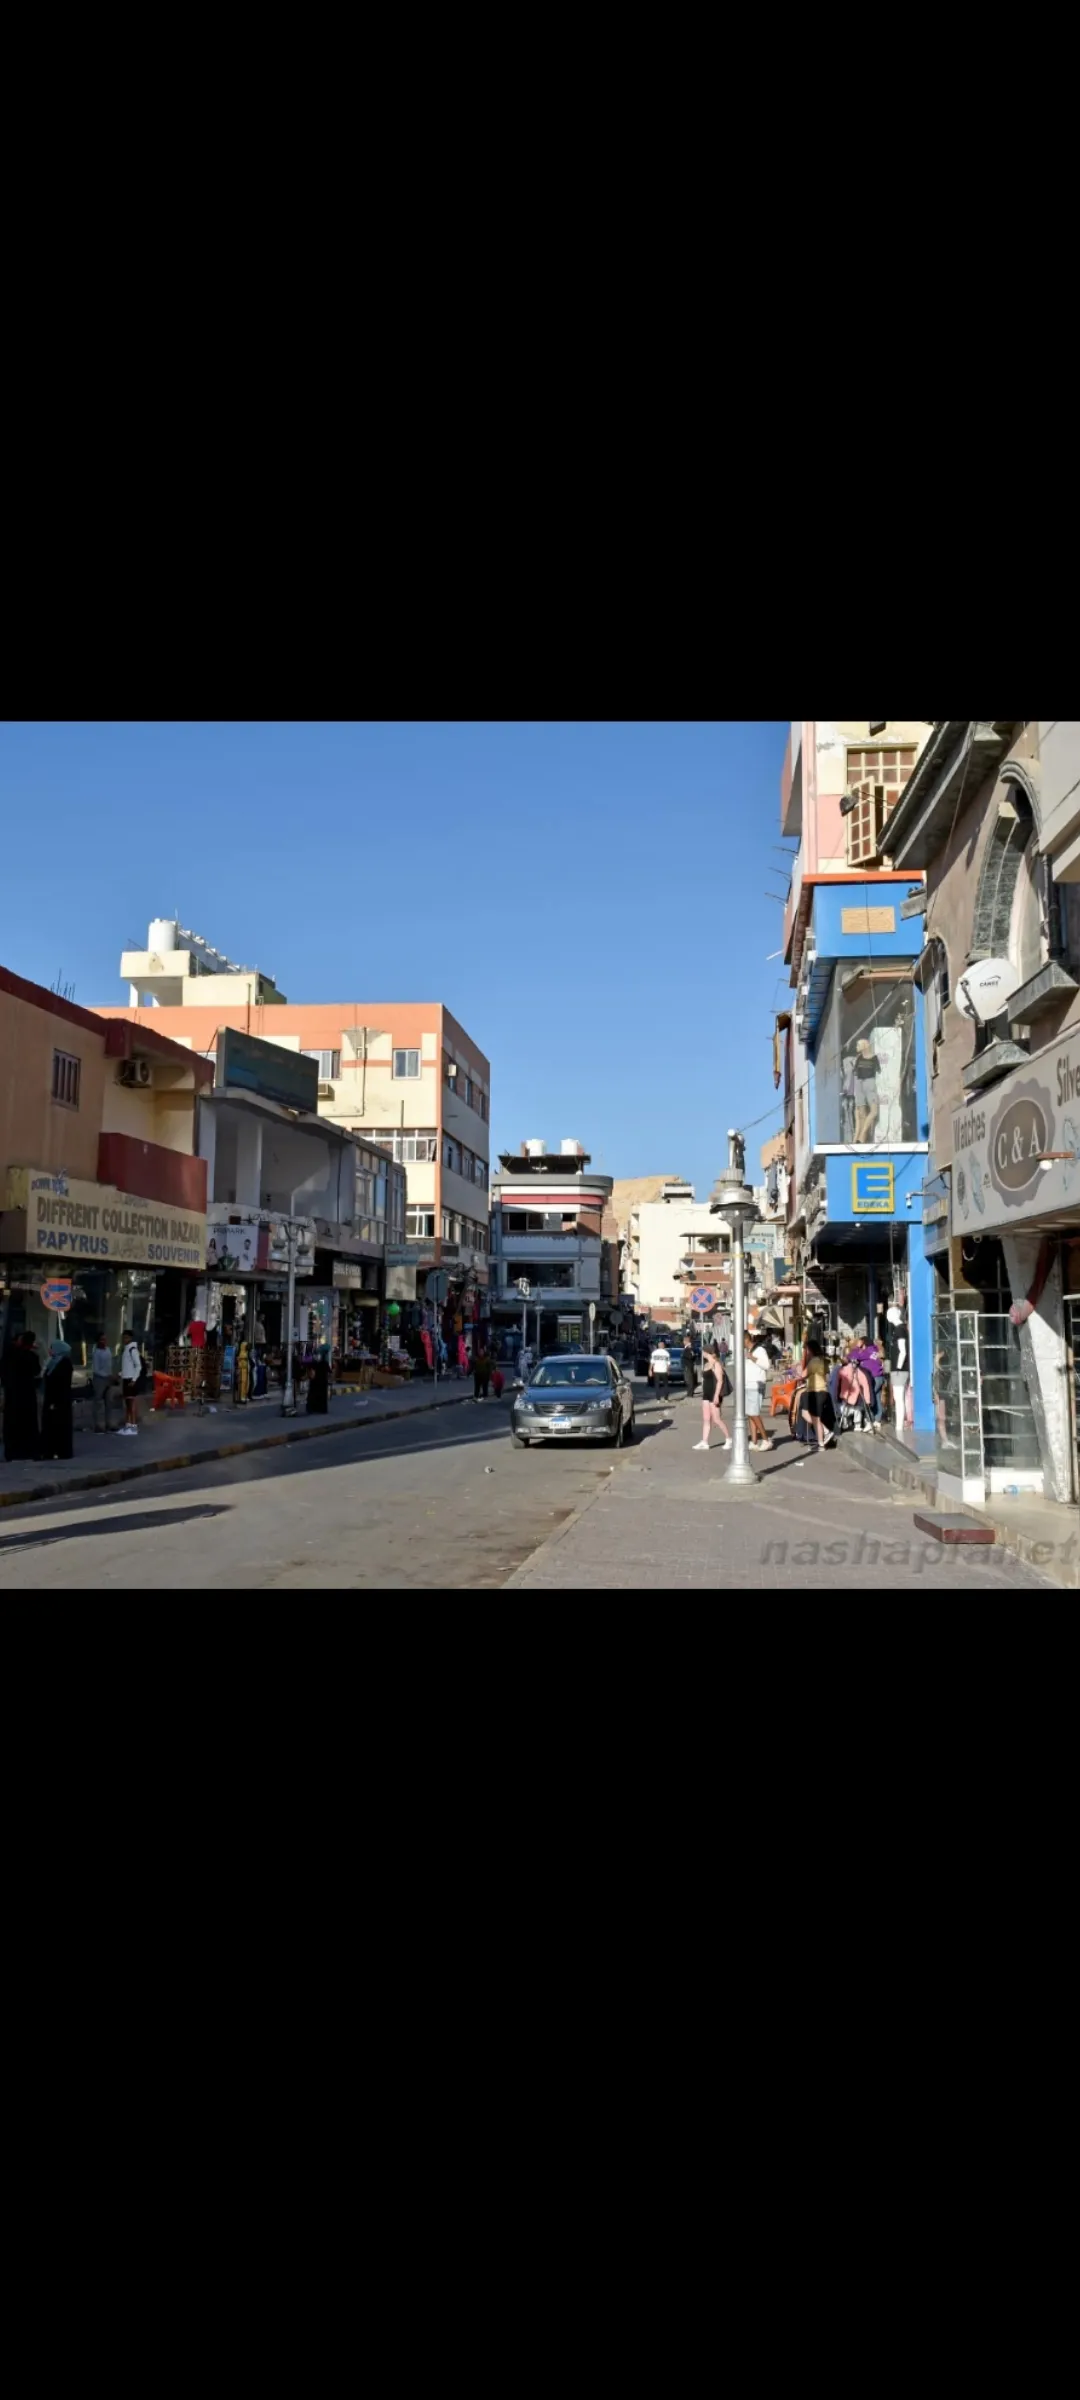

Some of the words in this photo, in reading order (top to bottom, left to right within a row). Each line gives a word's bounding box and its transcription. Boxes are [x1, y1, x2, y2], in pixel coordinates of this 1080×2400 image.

[953, 1110, 986, 1152] Watches
[37, 1196, 100, 1231] DIFFRENT
[102, 1208, 169, 1239] COLLECTION
[170, 1219, 201, 1245] BAZAR
[213, 1226, 246, 1235] PRIMARK
[37, 1229, 109, 1255] PAPYRUS
[148, 1243, 201, 1264] SOUVENIR
